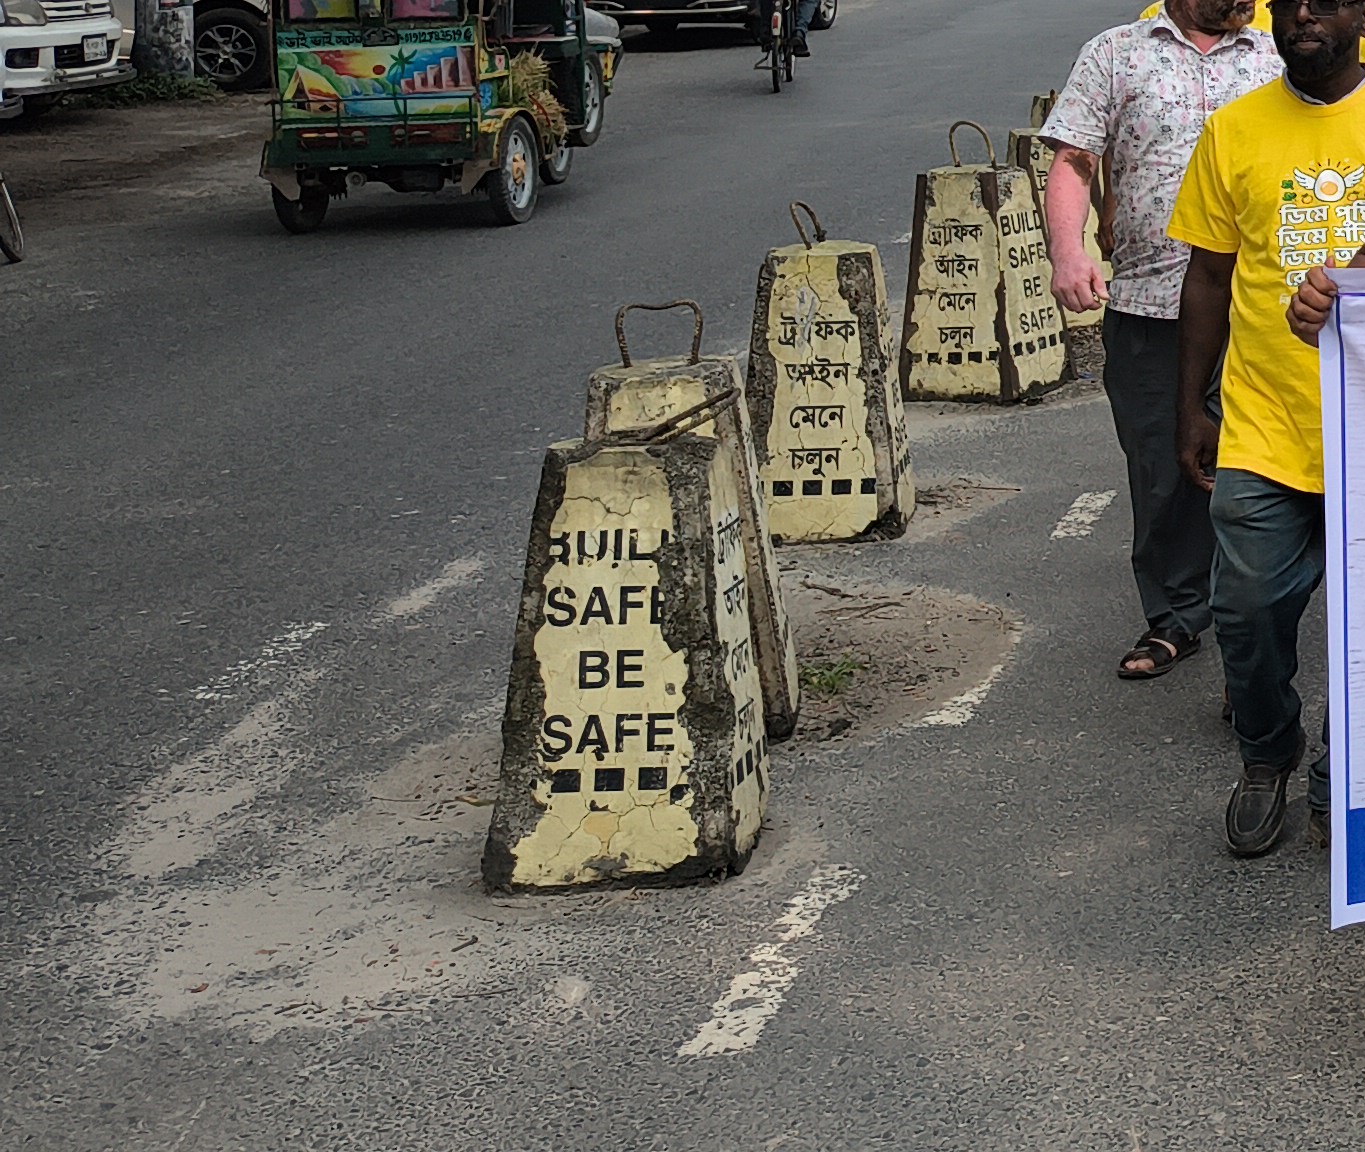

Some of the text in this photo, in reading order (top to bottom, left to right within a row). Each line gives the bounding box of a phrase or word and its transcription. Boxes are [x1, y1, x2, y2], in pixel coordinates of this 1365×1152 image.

[1000, 209, 1042, 238] BUILD
[1279, 204, 1330, 226] ডিমে
[1276, 225, 1330, 248] ডিমে
[934, 252, 979, 279] আইন
[1278, 247, 1329, 269] ডিমে
[1023, 275, 1043, 298] BE
[937, 291, 977, 312] মেনে
[938, 326, 975, 351] চলুন
[788, 403, 845, 430] মেনে
[790, 447, 841, 479] চলুন
[578, 649, 645, 690] BE
[541, 712, 675, 762] SAFE
